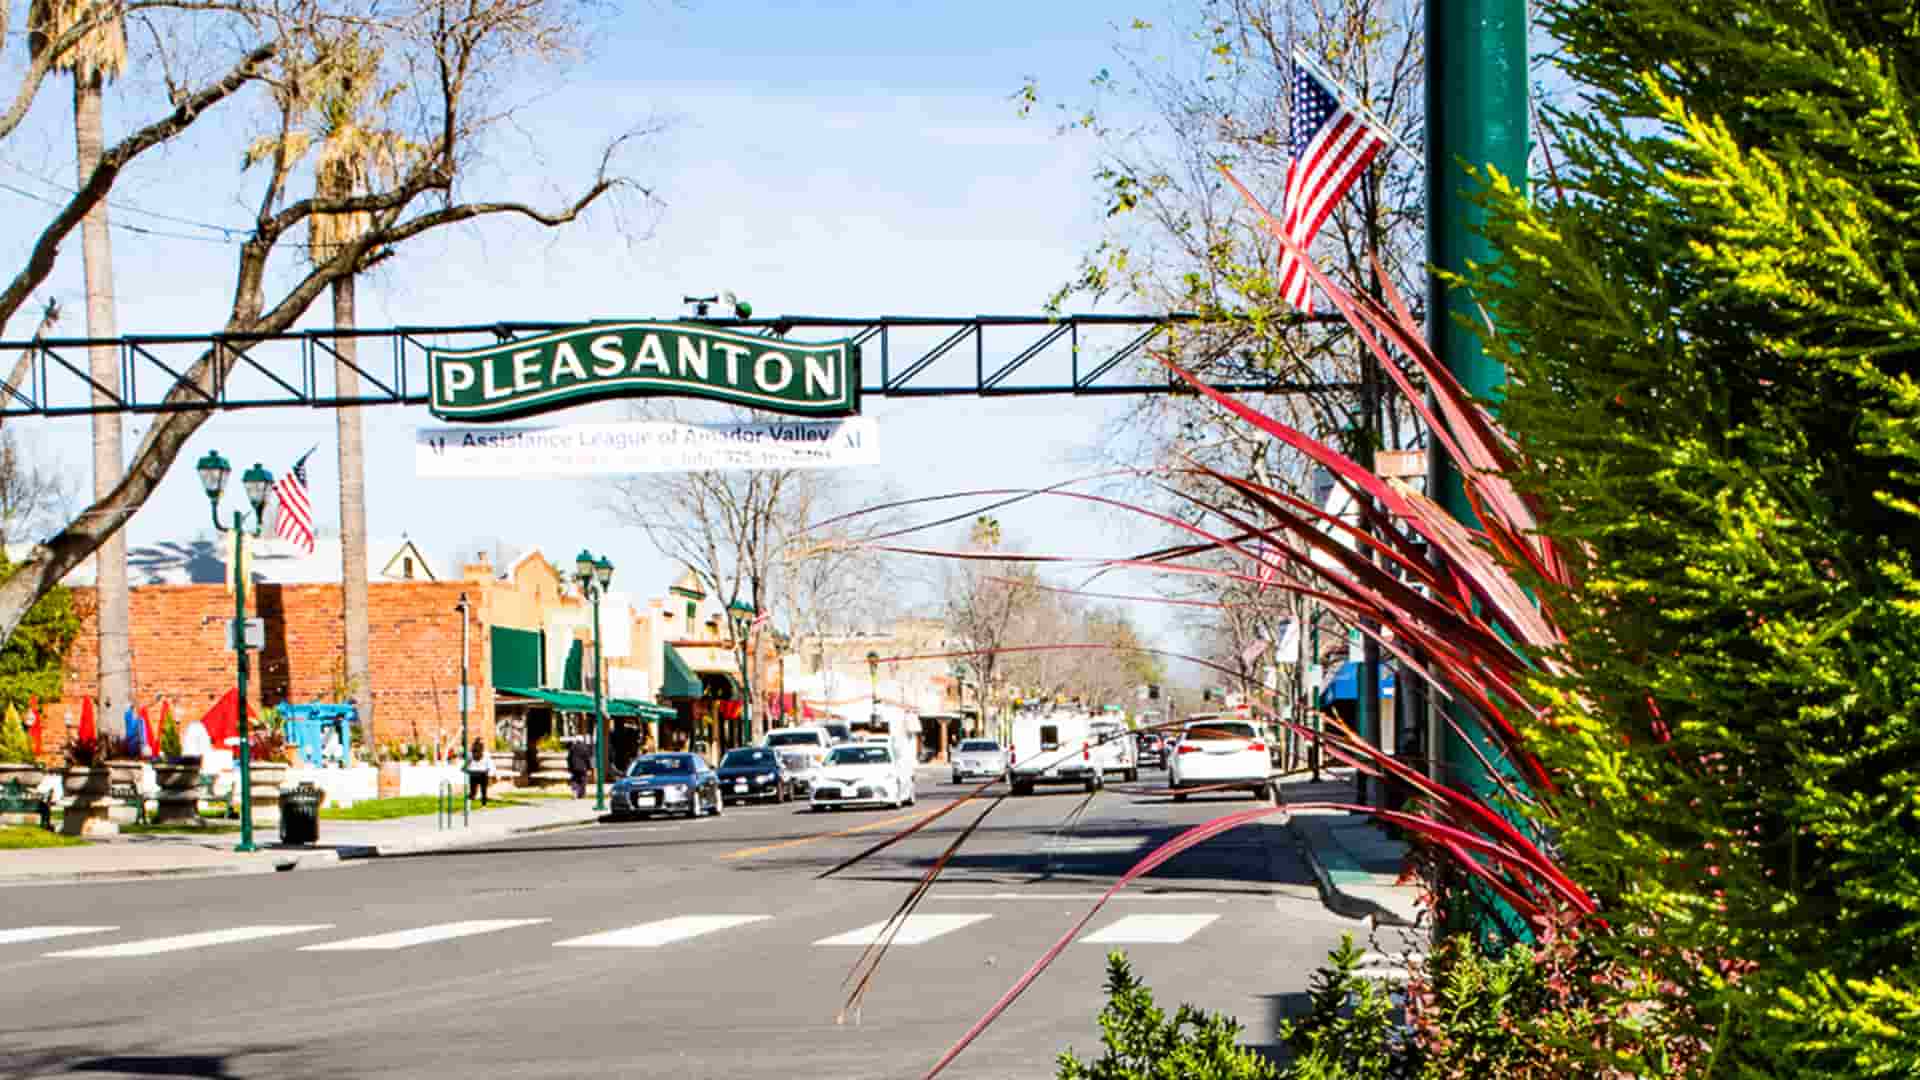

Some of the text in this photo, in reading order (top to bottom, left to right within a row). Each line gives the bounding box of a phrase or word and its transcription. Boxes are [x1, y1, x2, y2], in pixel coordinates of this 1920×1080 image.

[442, 332, 836, 403] PLEASANTON
[462, 431, 573, 449] Assistance
[768, 426, 831, 444] Valley
